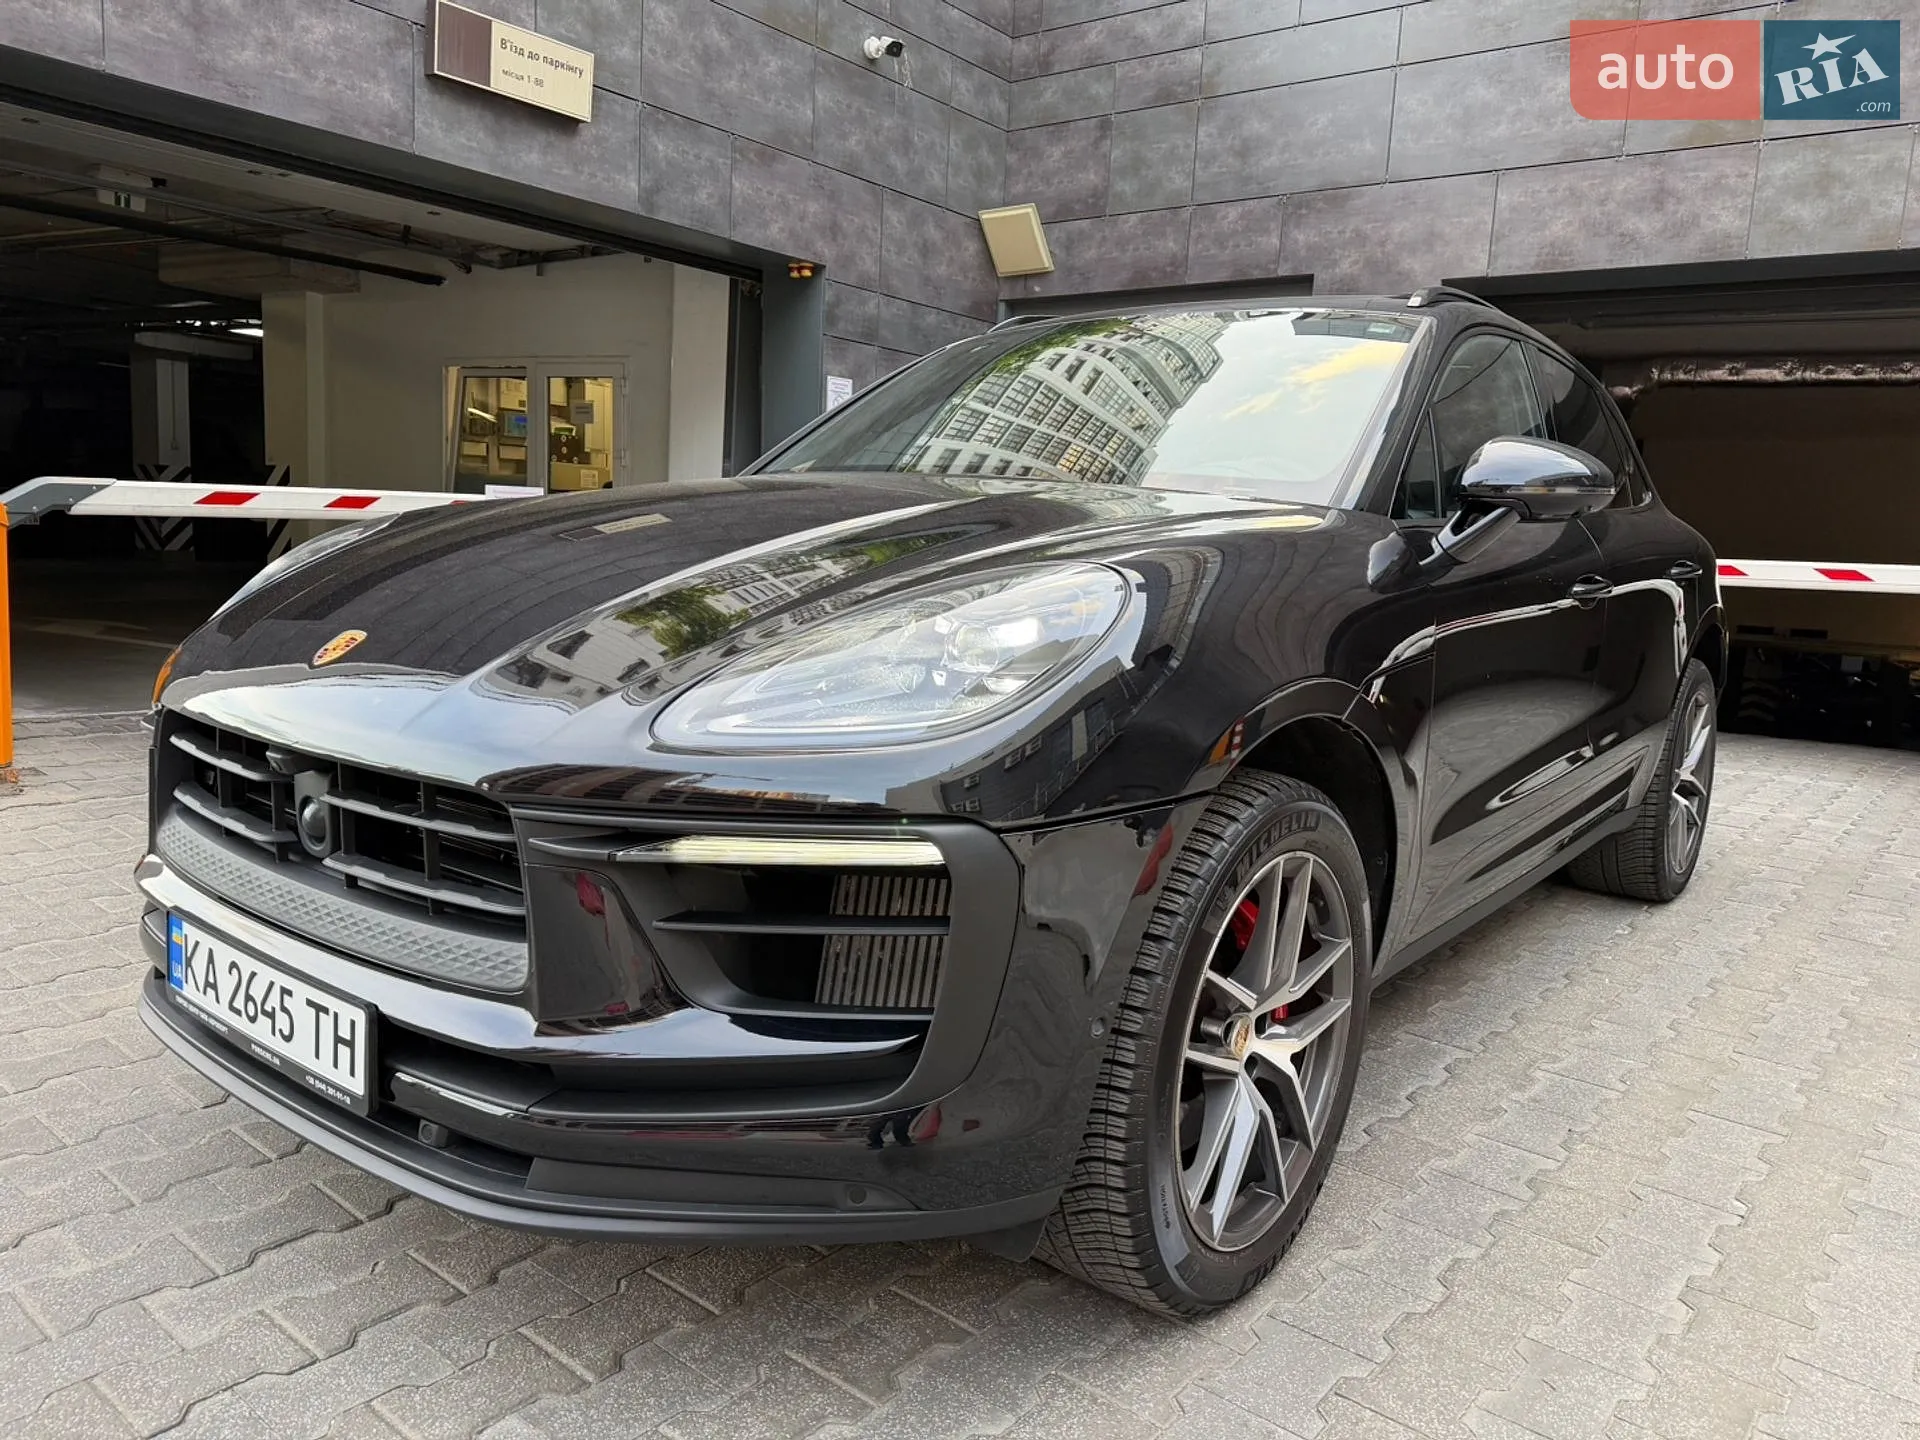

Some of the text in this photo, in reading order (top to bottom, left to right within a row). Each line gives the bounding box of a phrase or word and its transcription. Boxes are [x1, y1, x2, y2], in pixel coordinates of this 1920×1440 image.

[500, 38, 584, 79] В'їзд до паркінгу
[501, 67, 525, 82] місця
[1235, 810, 1321, 884] MICHELIN
[172, 960, 183, 979] UA
[184, 933, 221, 1005] KA
[227, 959, 295, 1044] 2645
[305, 996, 356, 1079] TH
